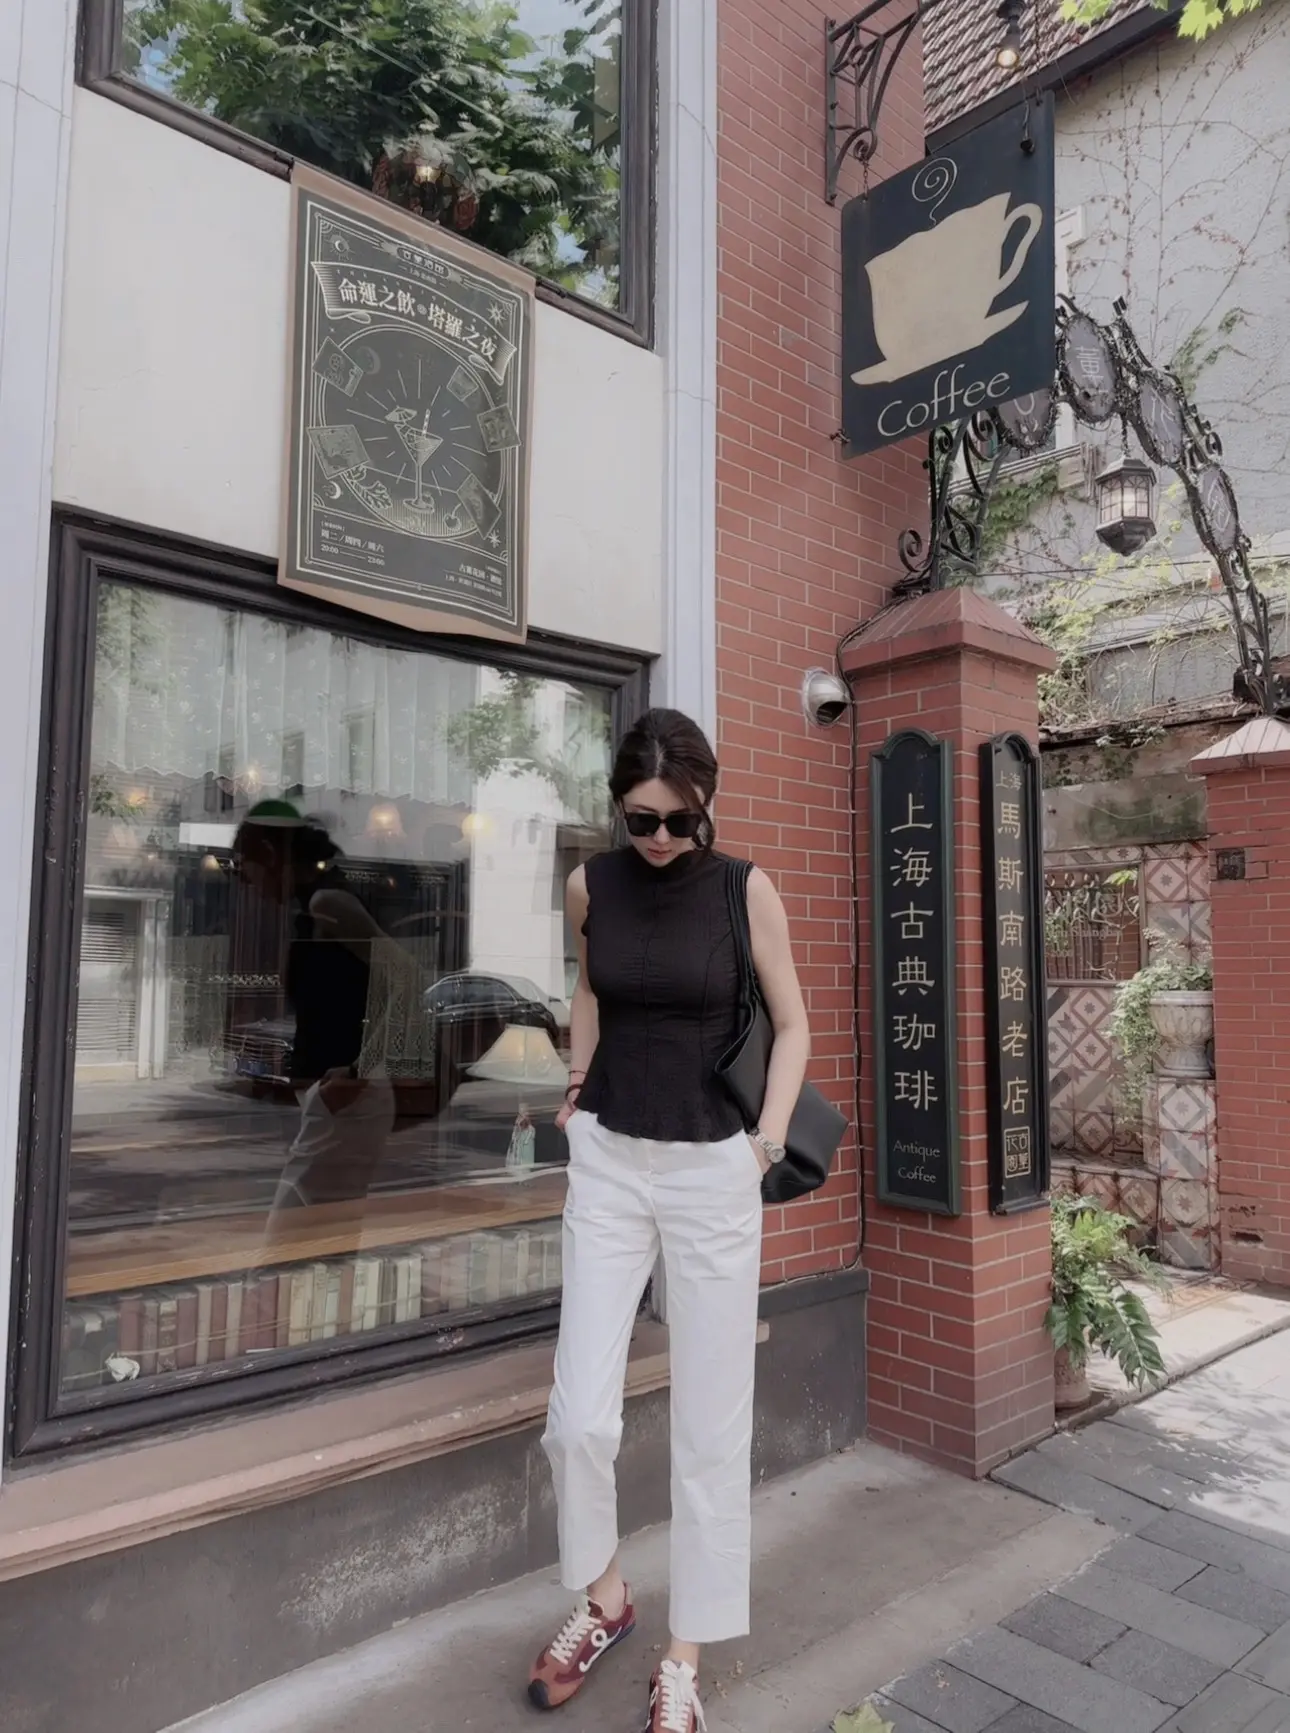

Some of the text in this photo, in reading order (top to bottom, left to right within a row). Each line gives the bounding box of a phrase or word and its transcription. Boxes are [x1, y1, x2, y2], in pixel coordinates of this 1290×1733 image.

[877, 363, 1011, 437] Coffee
[996, 770, 1023, 792] 上海
[890, 792, 939, 1112] 上海古典珈琲
[997, 801, 1030, 1115] 馬斯南路老店
[893, 1140, 941, 1162] Antique
[897, 1165, 937, 1184] Coffee
